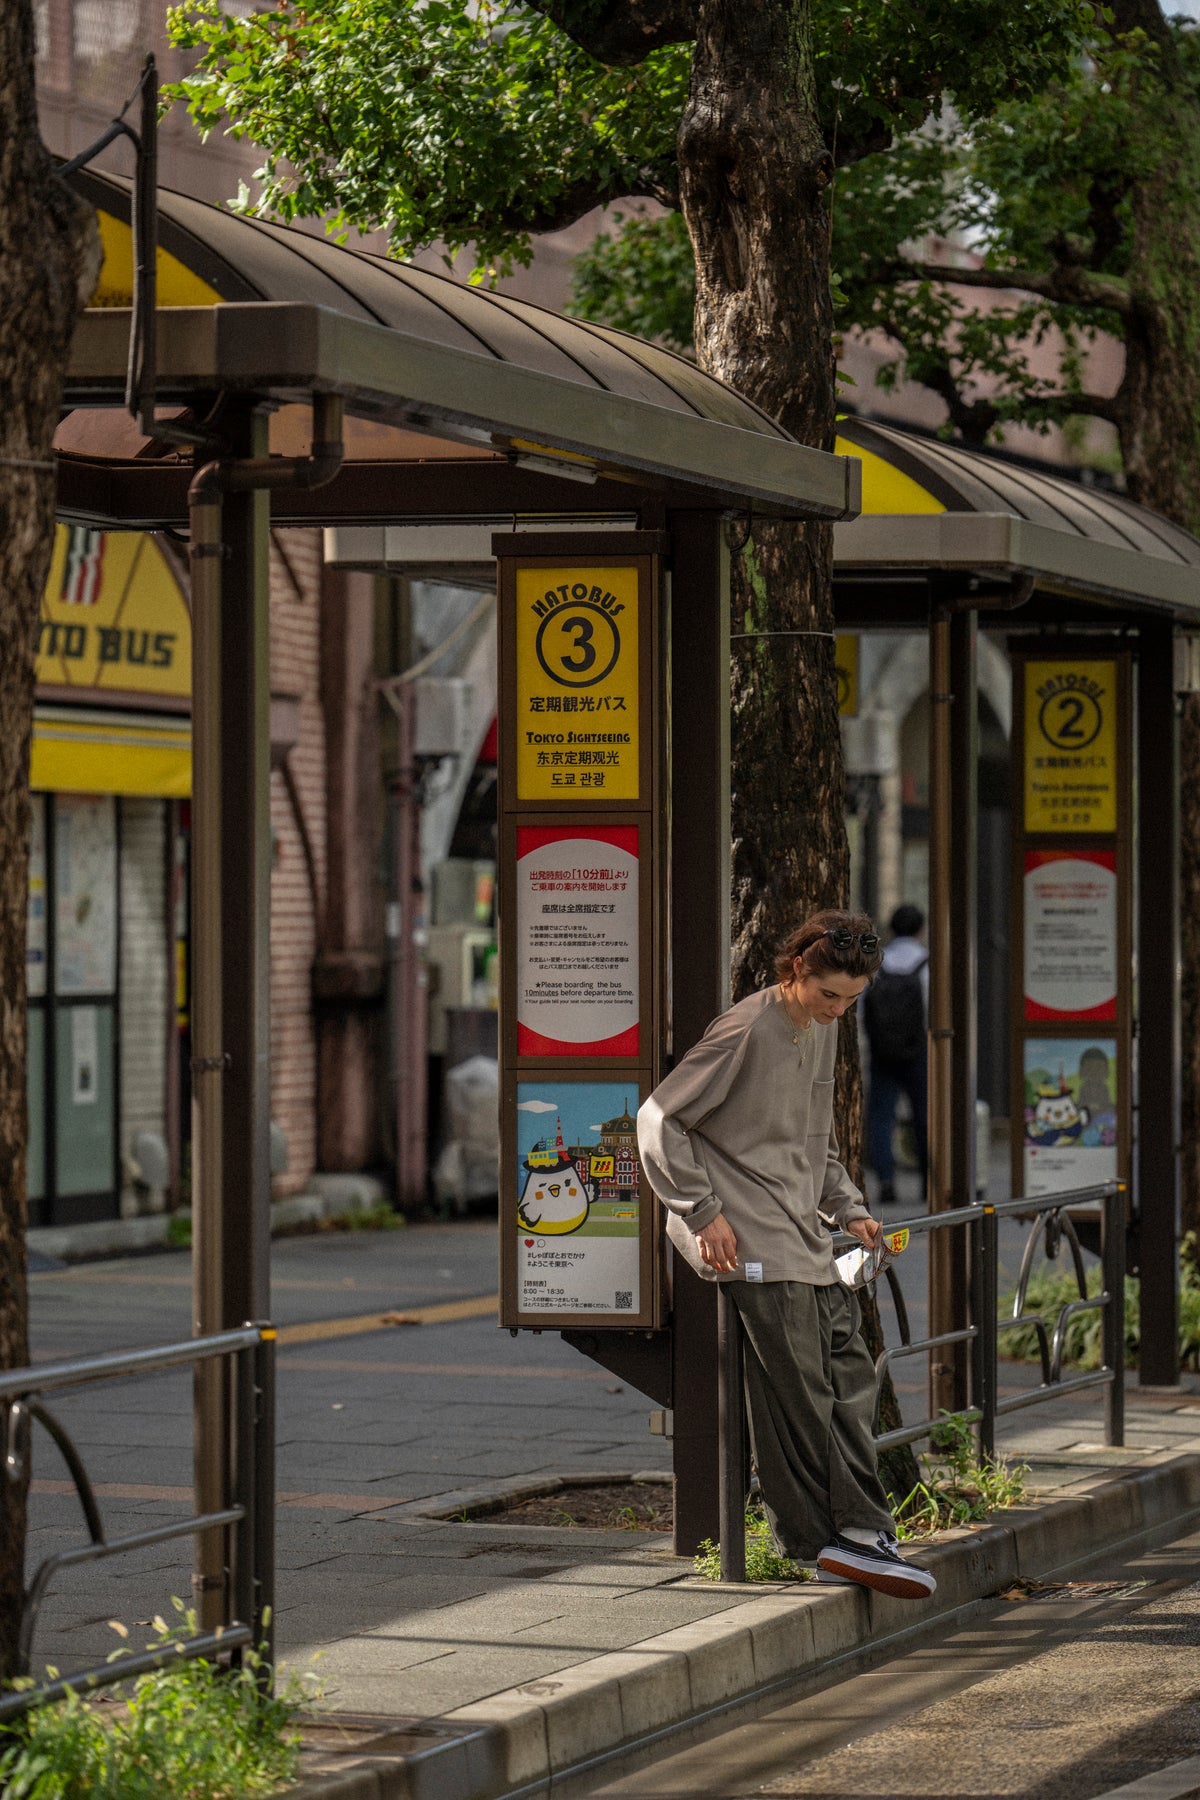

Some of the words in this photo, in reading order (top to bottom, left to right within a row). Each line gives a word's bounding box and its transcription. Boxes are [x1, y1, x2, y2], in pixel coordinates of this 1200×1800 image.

[531, 583, 626, 618] HATOBUS
[97, 625, 176, 668] BUS
[560, 616, 596, 672] 3
[529, 696, 627, 712] 定期観光バス
[1058, 697, 1085, 738] 2
[537, 751, 620, 765] 东京定期观光
[551, 773, 576, 786] 도쿄
[580, 773, 605, 786] 관광
[529, 869, 629, 880] 出発時刻の「10分前」より
[531, 883, 628, 891] ご乗車の案内を開始します
[542, 904, 616, 913] 座席は全席指定です
[564, 981, 594, 990] boarding
[584, 989, 616, 997] departure
